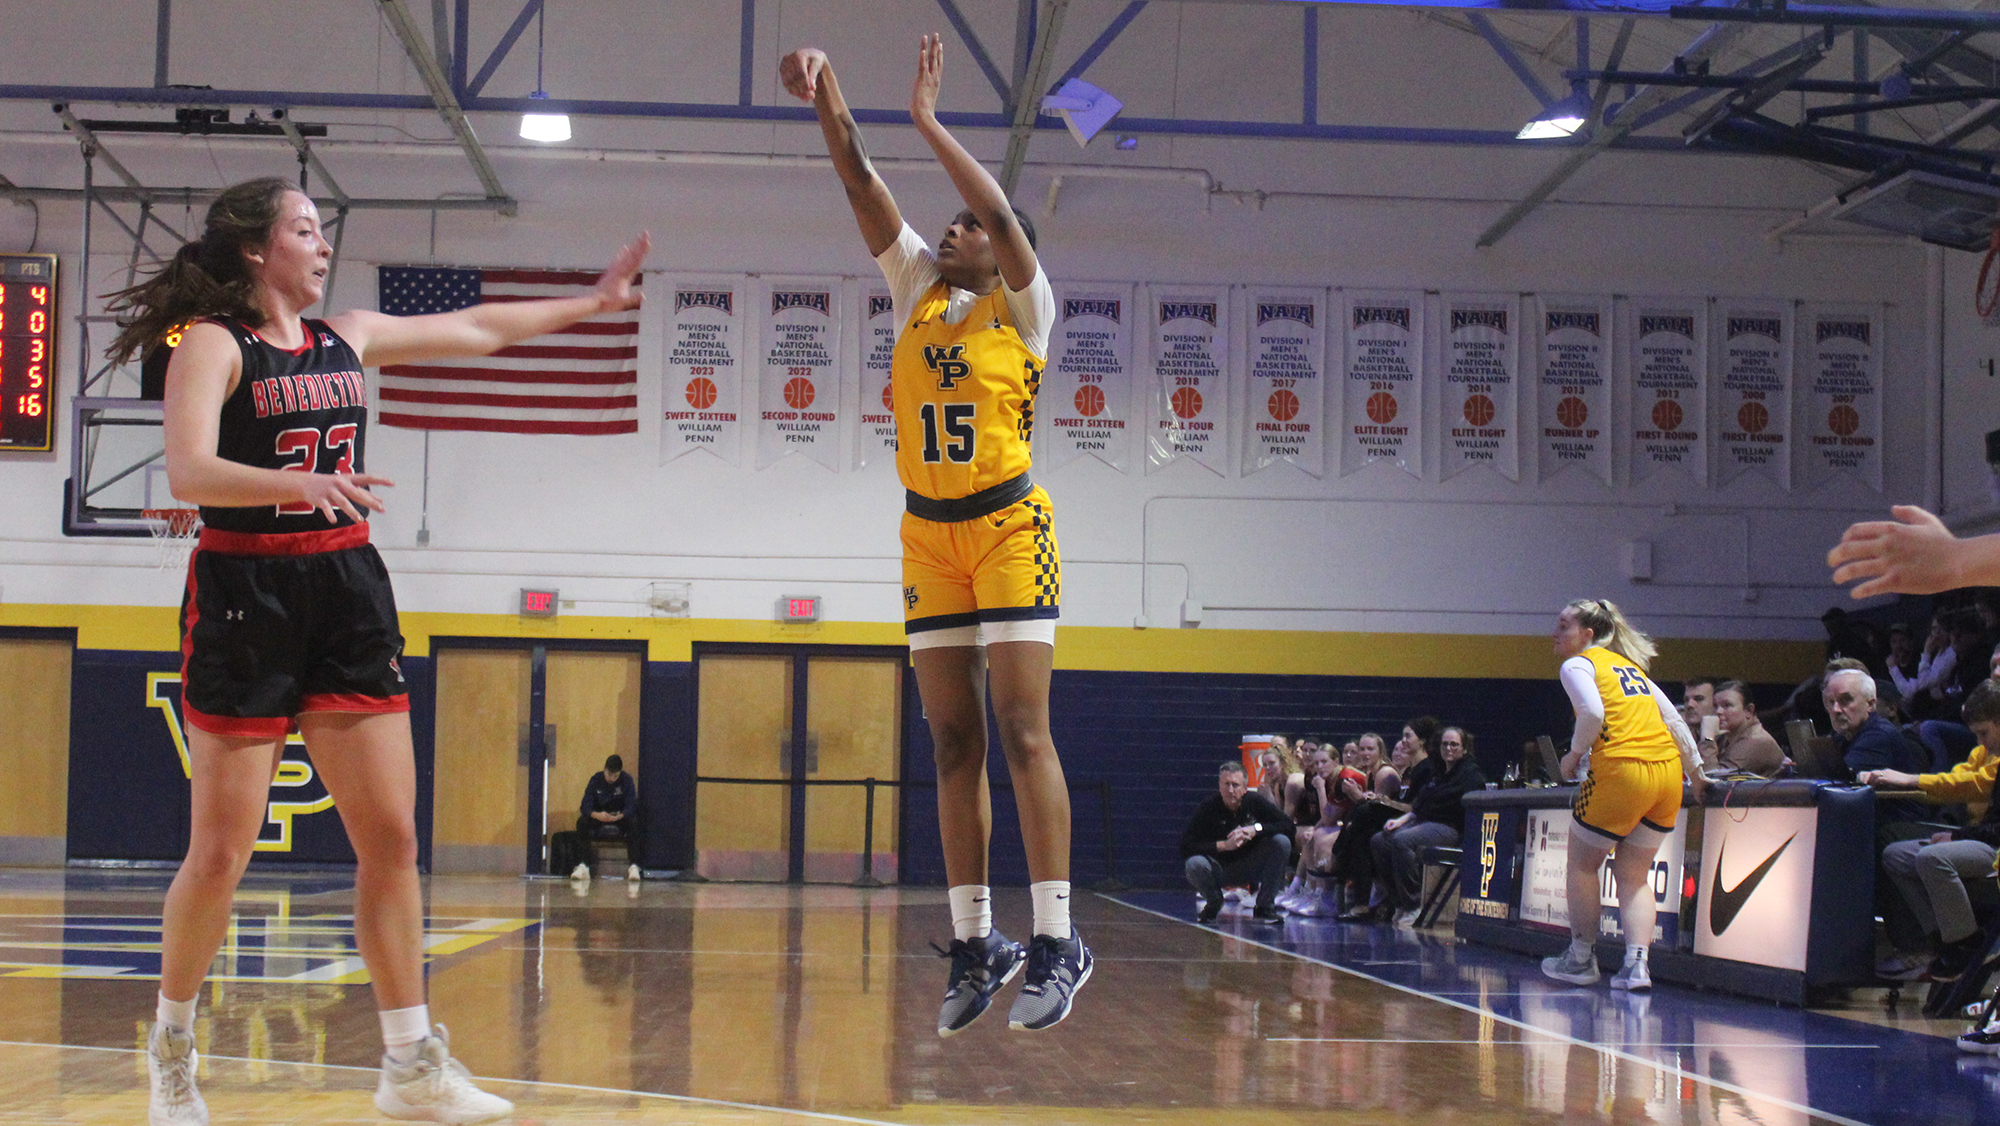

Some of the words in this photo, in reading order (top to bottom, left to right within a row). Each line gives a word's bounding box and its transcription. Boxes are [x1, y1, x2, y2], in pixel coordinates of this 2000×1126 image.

[21, 263, 40, 275] PTS
[30, 286, 46, 305] 4
[676, 291, 731, 313] NAIA
[773, 292, 829, 314] NAIA
[1063, 299, 1120, 321] NAIA
[1160, 303, 1216, 324] NAIA
[1258, 304, 1313, 326] NAIA
[1354, 307, 1409, 329] NAIA
[29, 310, 45, 333] 0
[1452, 310, 1507, 332] NAIA
[1546, 313, 1599, 333] NAIA
[678, 324, 721, 332] DIVISION
[1640, 316, 1693, 337] NAIA
[1728, 318, 1780, 340] NAIA
[1817, 321, 1869, 342] NAIA
[1066, 332, 1109, 340] DIVISION
[1163, 335, 1205, 343] DIVISION
[679, 341, 726, 349] NATIONAL
[1261, 337, 1303, 345] DIVISION
[1358, 339, 1400, 347] DIVISION
[776, 341, 824, 350] NATIONAL
[1454, 342, 1495, 350] DIVISION
[1548, 344, 1588, 352] DIVISION
[30, 339, 45, 362] 3
[673, 349, 730, 357] BASKETBALL
[771, 350, 828, 358] BASKETBALL
[1067, 348, 1114, 357] NATIONAL
[1730, 350, 1770, 358] DIVISION
[1164, 352, 1211, 360] NATIONAL
[1261, 353, 1308, 362] NATIONAL
[1358, 356, 1405, 364] NATIONAL
[1819, 353, 1859, 361] DIVISION
[669, 358, 734, 366] TOURNAMENT
[767, 358, 832, 366] TOURNAMENT
[1062, 357, 1118, 365] BASKETBALL
[1159, 360, 1215, 368] BASKETBALL
[1456, 359, 1503, 367] NATIONAL
[1550, 361, 1595, 369] NATIONAL
[1058, 365, 1123, 373] TOURNAMENT
[1256, 362, 1312, 370] BASKETBALL
[1353, 364, 1410, 373] BASKETBALL
[1645, 364, 1690, 372] NATIONAL
[1732, 366, 1777, 374] NATIONAL
[690, 367, 714, 375] 2023
[788, 368, 812, 376] 2022
[1156, 368, 1219, 377] TOURNAMENT
[1253, 370, 1317, 379] TOURNAMENT
[1546, 369, 1599, 377] BASKETBALL
[1822, 370, 1867, 378] NATIONAL
[28, 365, 43, 388] 5
[1079, 374, 1102, 383] 2019
[1350, 373, 1413, 381] TOURNAMENT
[1448, 376, 1511, 384] TOURNAMENT
[1727, 375, 1780, 383] BASKETBALL
[1175, 377, 1199, 386] 2018
[1272, 379, 1296, 388] 2017
[1542, 378, 1603, 386] TOURNAMENT
[1637, 381, 1698, 389] TOURNAMENT
[1817, 378, 1869, 386] BASKETBALL
[1370, 382, 1394, 390] 2016
[1468, 385, 1491, 393] 2014
[1724, 383, 1784, 391] TOURNAMENT
[1814, 386, 1874, 394] TOURNAMENT
[1657, 390, 1679, 398] 2012
[18, 393, 42, 416] 16
[665, 412, 695, 420] SWEET
[698, 412, 736, 421] SIXTEEN
[762, 412, 798, 420] SECOND
[802, 413, 835, 421] ROUND
[862, 415, 892, 423] SWEET
[1054, 418, 1084, 427] SWEET
[1087, 419, 1125, 429] SIXTEEN
[1188, 422, 1214, 431] FOUR
[1256, 423, 1282, 431] FINAL
[1285, 424, 1310, 432] FOUR
[678, 424, 722, 432] WILLIAM
[777, 424, 820, 432] WILLIAM
[1354, 426, 1378, 435] ELITE
[1381, 427, 1408, 436] EIGHT
[919, 402, 975, 464] 15
[1067, 430, 1111, 439] WILLIAM
[1452, 429, 1476, 437] ELITE
[1479, 429, 1506, 438] EIGHT
[1545, 429, 1583, 438] RUNNER
[1587, 430, 1599, 438] UP
[1665, 432, 1698, 440] ROUND
[786, 435, 814, 443] PENN
[1261, 435, 1305, 443] WILLIAM
[1358, 437, 1402, 445] WILLIAM
[1723, 433, 1747, 441] FIRST
[1751, 434, 1783, 442] ROUND
[1813, 437, 1838, 445] FIRST
[1175, 444, 1203, 452] PENN
[1456, 440, 1499, 448] WILLIAM
[1552, 443, 1594, 451] WILLIAM
[1270, 446, 1299, 455] PENN
[1368, 449, 1396, 457] PENN
[1646, 445, 1689, 453] WILLIAM
[1732, 448, 1773, 456] WILLIAM
[1465, 452, 1493, 460] PENN
[1558, 452, 1586, 460] PENN
[1653, 454, 1681, 462] PENN
[1823, 451, 1865, 459] WILLIAM
[526, 592, 552, 612] EXIT
[789, 599, 814, 617] EXIT
[1612, 666, 1651, 697] 25
